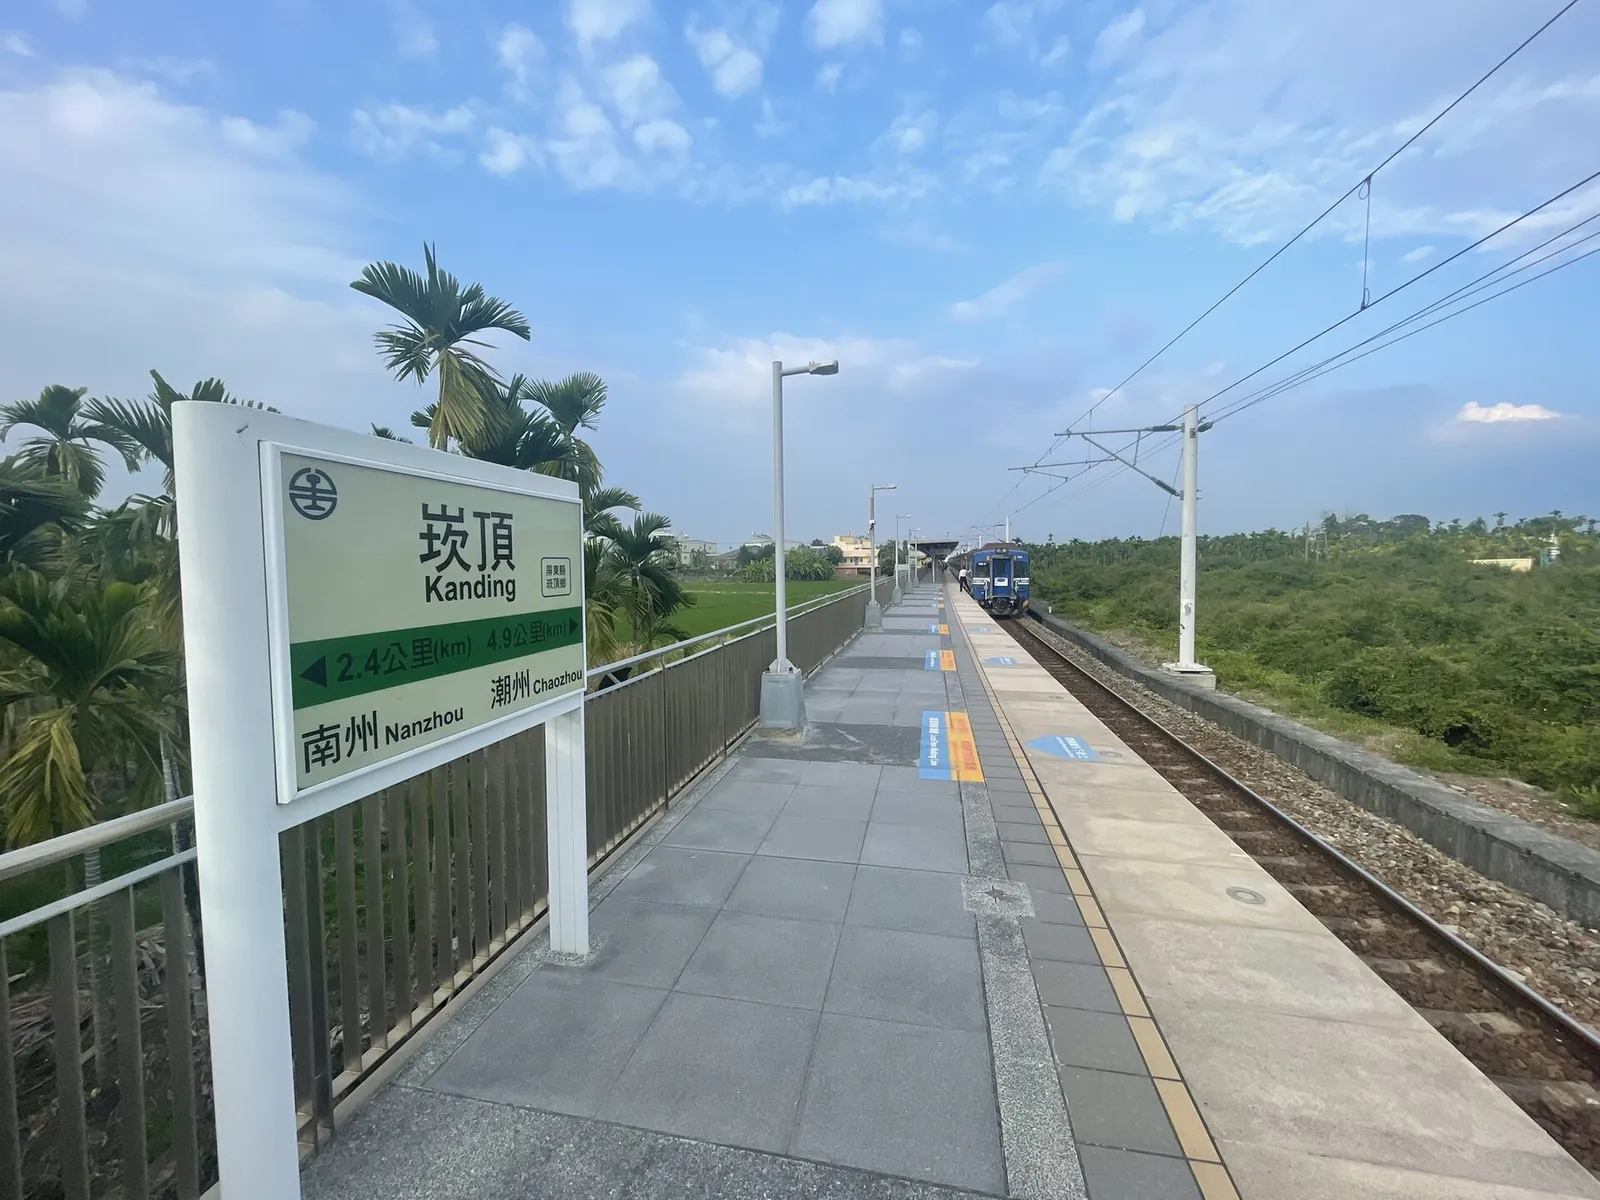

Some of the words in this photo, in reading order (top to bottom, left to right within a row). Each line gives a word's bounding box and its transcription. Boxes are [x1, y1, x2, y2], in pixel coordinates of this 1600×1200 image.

[419, 503, 516, 573] 崁頂
[425, 574, 516, 603] Kanding
[490, 669, 530, 710] 潮州
[533, 668, 583, 695] Chaozhou
[302, 711, 379, 774] 南州
[385, 707, 464, 745] Nanzhou
